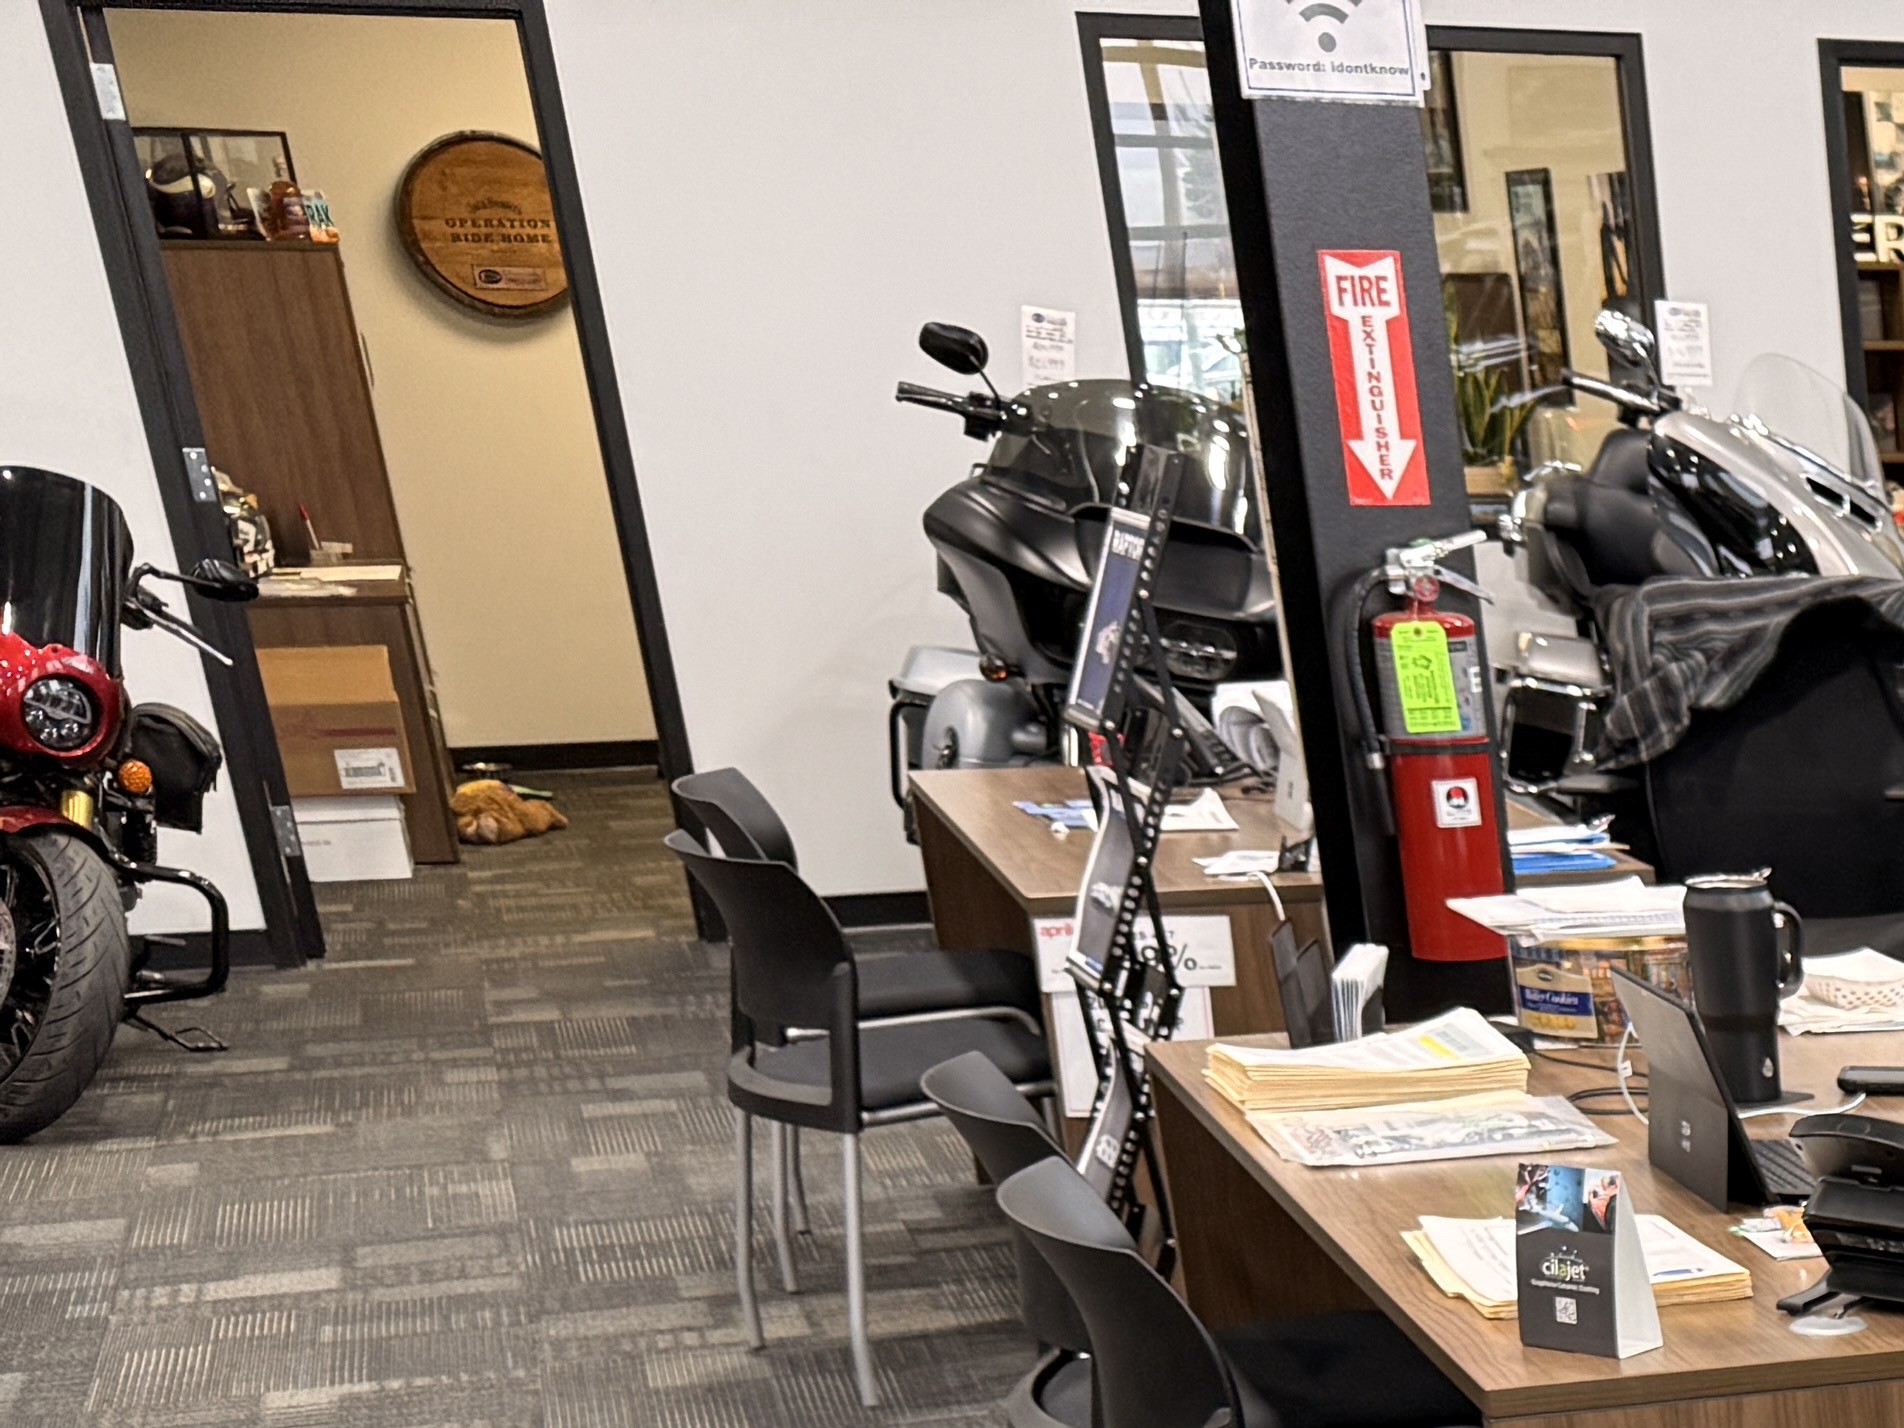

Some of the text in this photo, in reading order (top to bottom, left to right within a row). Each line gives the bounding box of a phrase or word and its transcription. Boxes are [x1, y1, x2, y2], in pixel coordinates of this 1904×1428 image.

[1249, 57, 1325, 73] Password:
[444, 218, 551, 229] OPERATION
[450, 232, 551, 244] RIDE HOME
[1335, 274, 1392, 308] FIRE
[1360, 315, 1394, 481] EXTINGUISHER
[1541, 1257, 1587, 1282] cilajet
